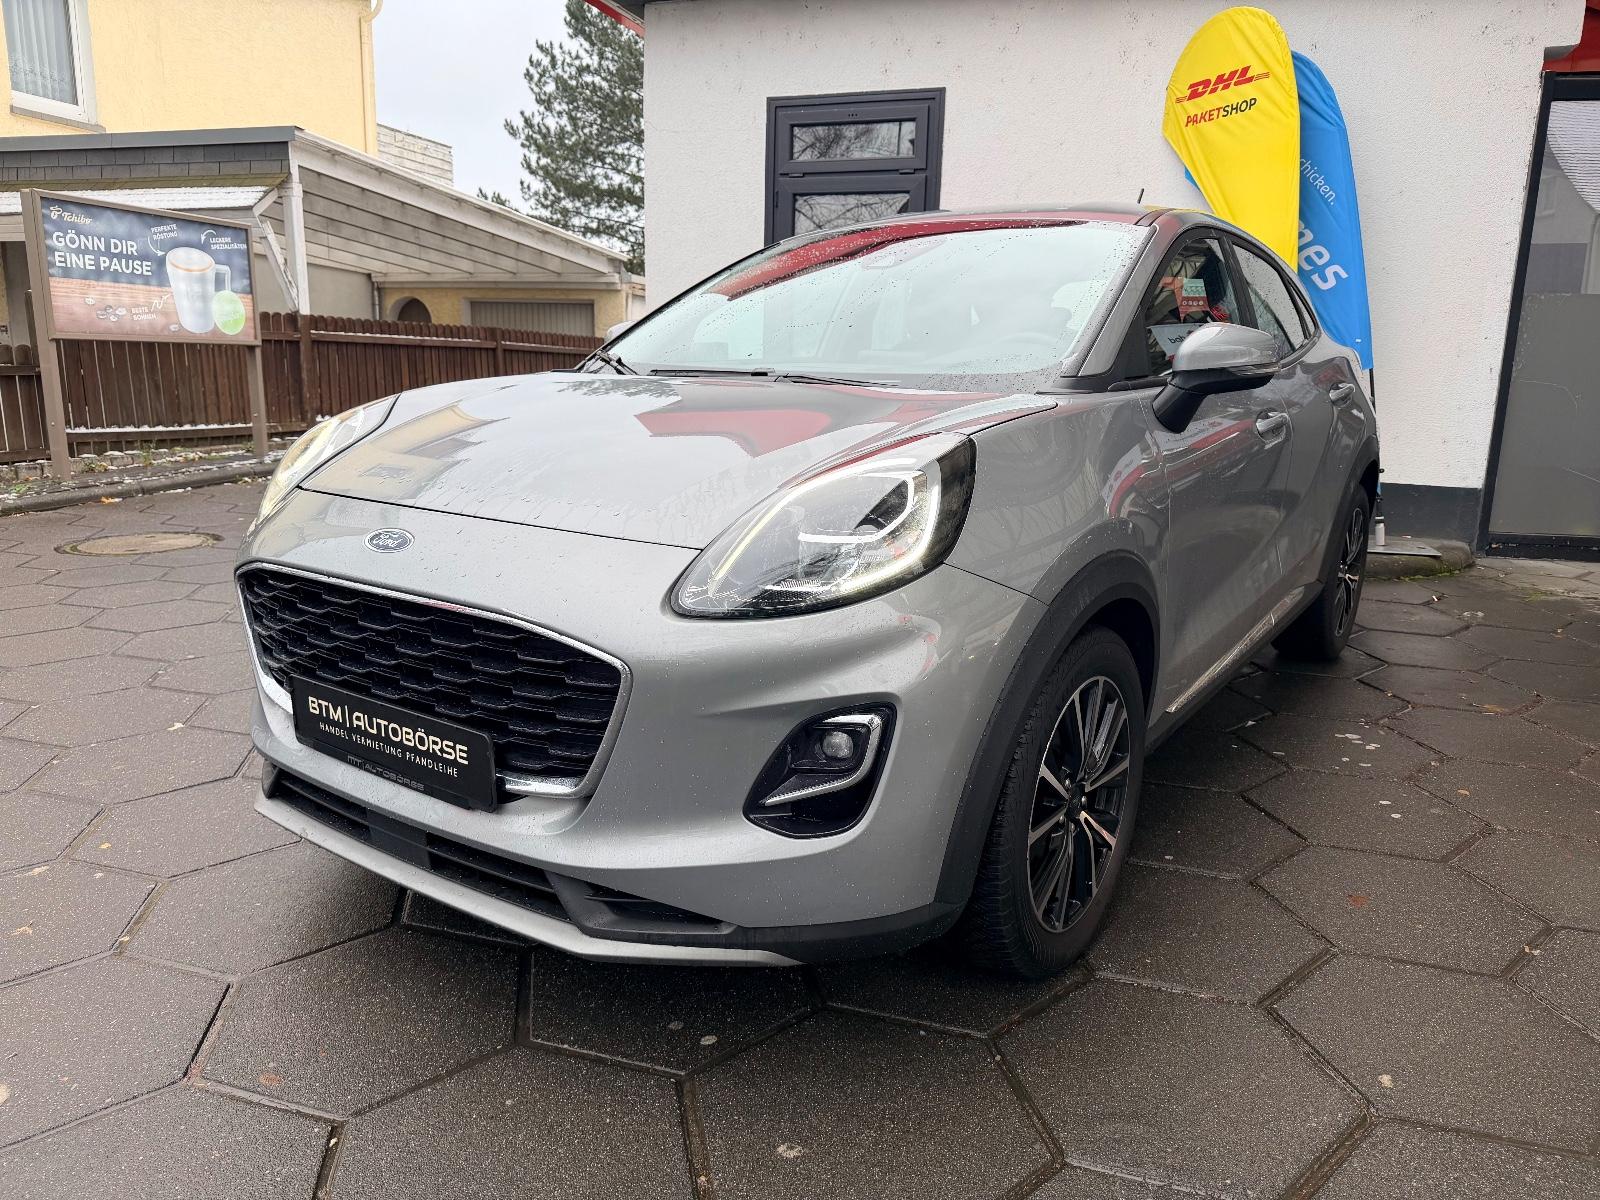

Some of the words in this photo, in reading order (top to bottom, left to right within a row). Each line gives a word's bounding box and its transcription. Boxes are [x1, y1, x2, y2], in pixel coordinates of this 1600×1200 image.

[1186, 65, 1255, 101] DHL
[1185, 97, 1257, 127] PAKETSHOP
[62, 212, 92, 224] Tchibo
[151, 223, 178, 234] PERFEKTE
[53, 229, 105, 252] GÖNN
[110, 238, 138, 256] DIR
[55, 251, 96, 270] EINE
[100, 256, 152, 276] PAUSE
[308, 696, 342, 722] BTM
[353, 711, 469, 765] AUTOBÖRSE
[319, 721, 349, 740] HANDEL
[351, 731, 402, 758] VERMIETUNG
[405, 751, 458, 778] PFANDLEIHE
